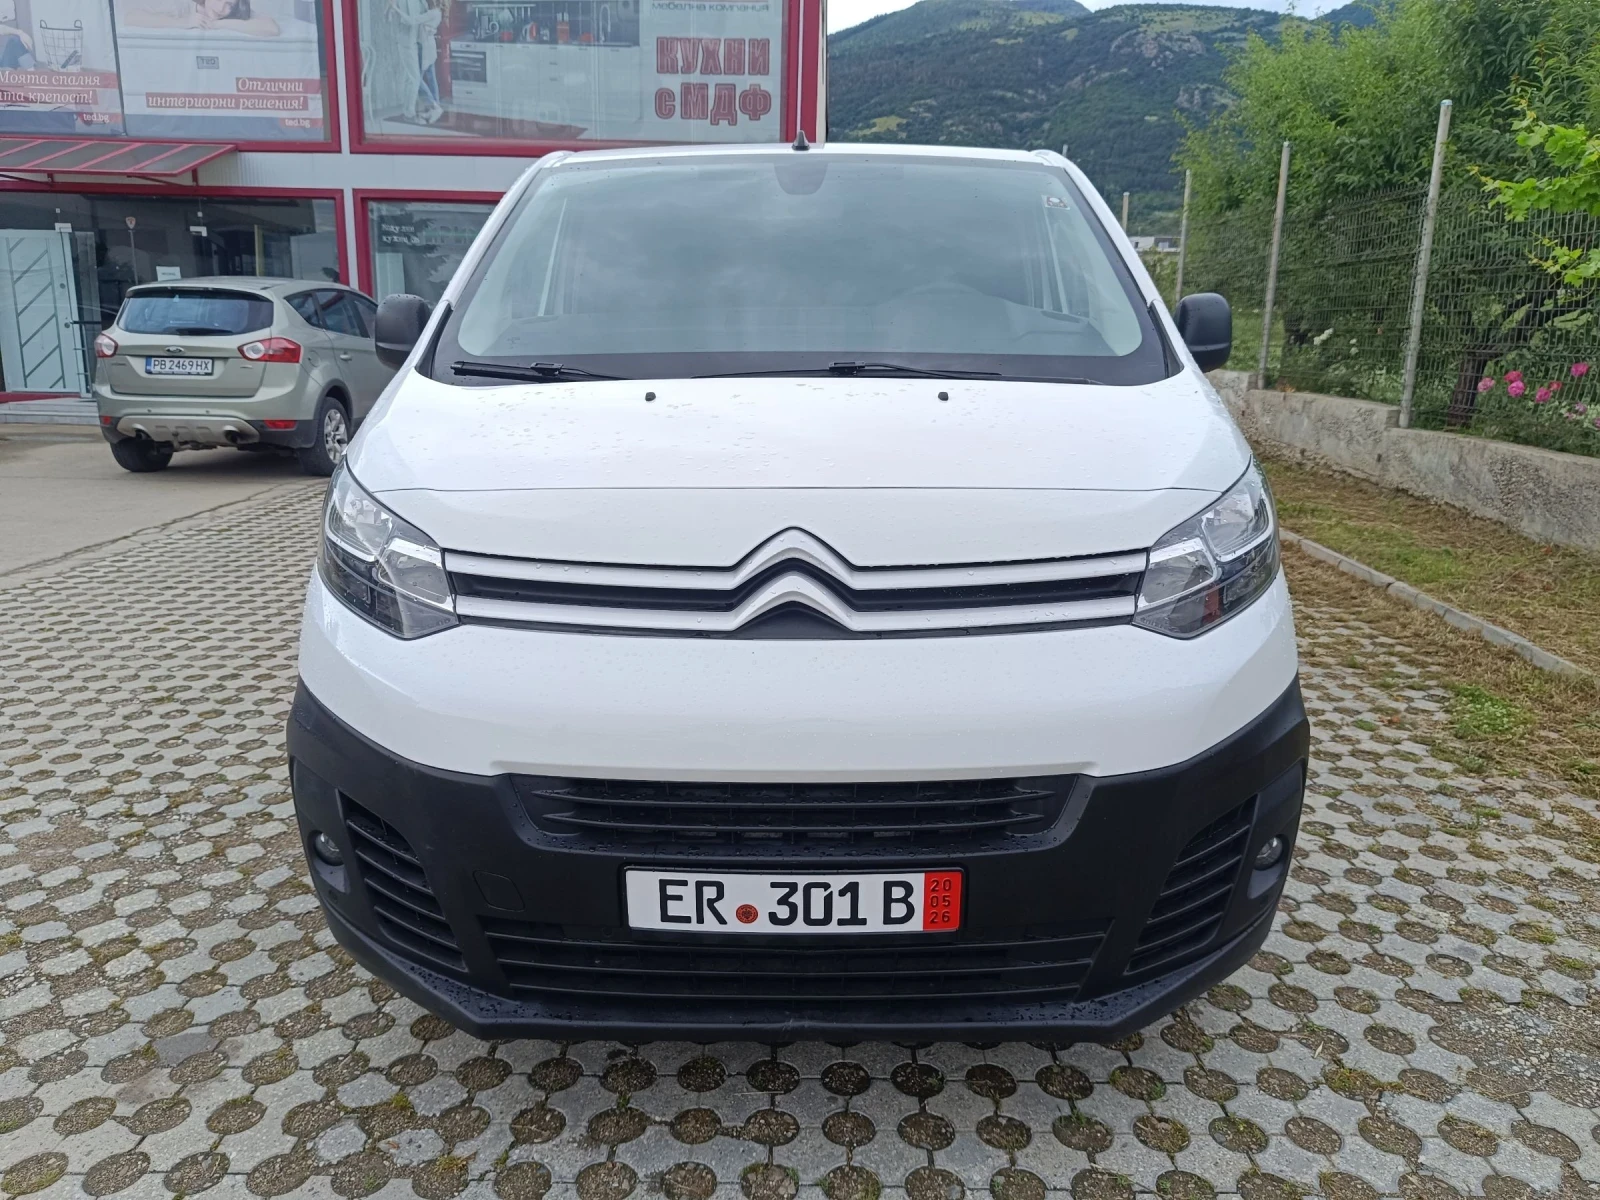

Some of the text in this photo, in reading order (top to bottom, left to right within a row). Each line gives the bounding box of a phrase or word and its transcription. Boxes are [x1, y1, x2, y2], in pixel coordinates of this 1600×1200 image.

[656, 36, 770, 76] КУХНИ
[0, 71, 101, 86] Моята спалня
[238, 78, 303, 92] Отлични
[29, 90, 93, 104] крепост!
[148, 96, 304, 111] интериорни решения!
[83, 113, 109, 123] ted.bg
[285, 118, 311, 128] ted.bg
[169, 360, 194, 370] 2469
[930, 879, 952, 892] 20
[658, 878, 914, 926] ER 301 B
[930, 895, 951, 908] 05
[929, 911, 951, 924] 26
